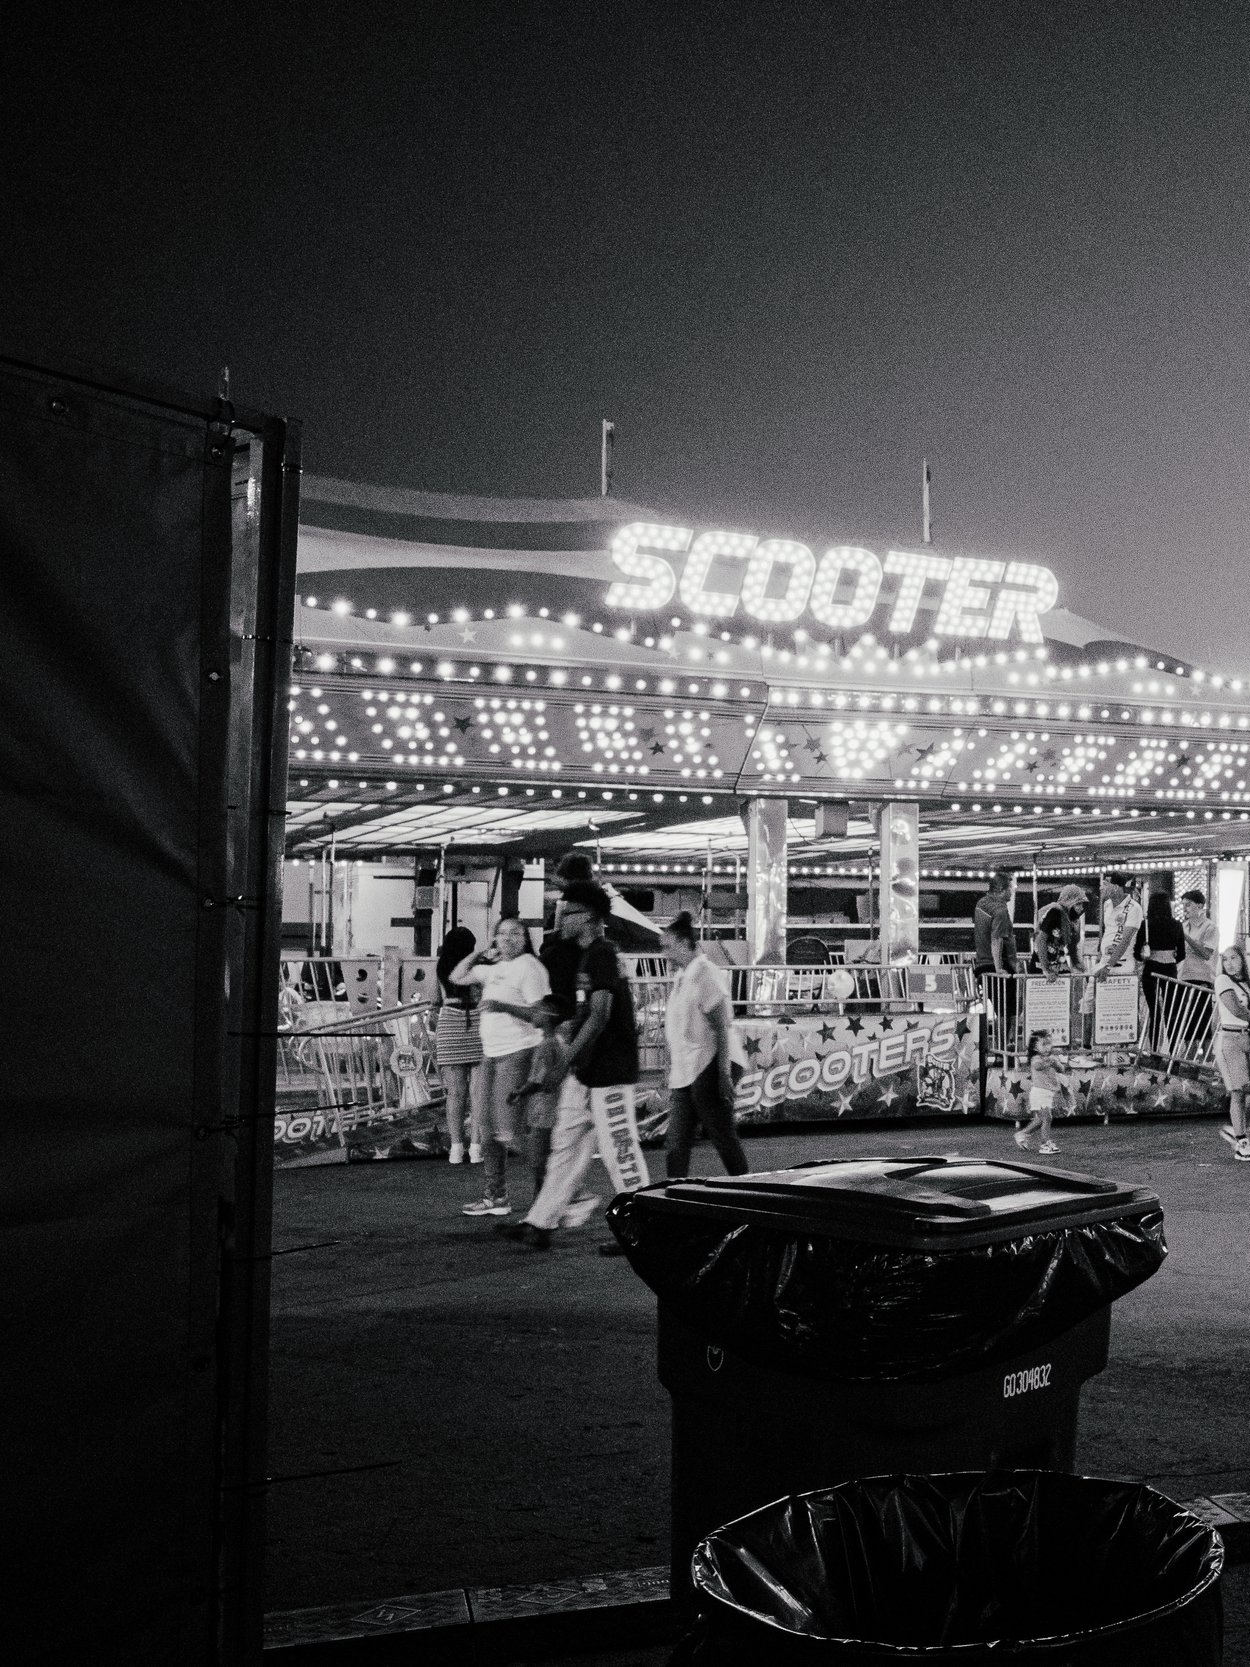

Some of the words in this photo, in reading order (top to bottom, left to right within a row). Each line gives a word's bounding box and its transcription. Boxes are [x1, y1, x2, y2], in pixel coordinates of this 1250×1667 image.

[604, 521, 1059, 643] SCOOTER
[924, 974, 938, 992] 5
[734, 1020, 957, 1110] SCOOTERS
